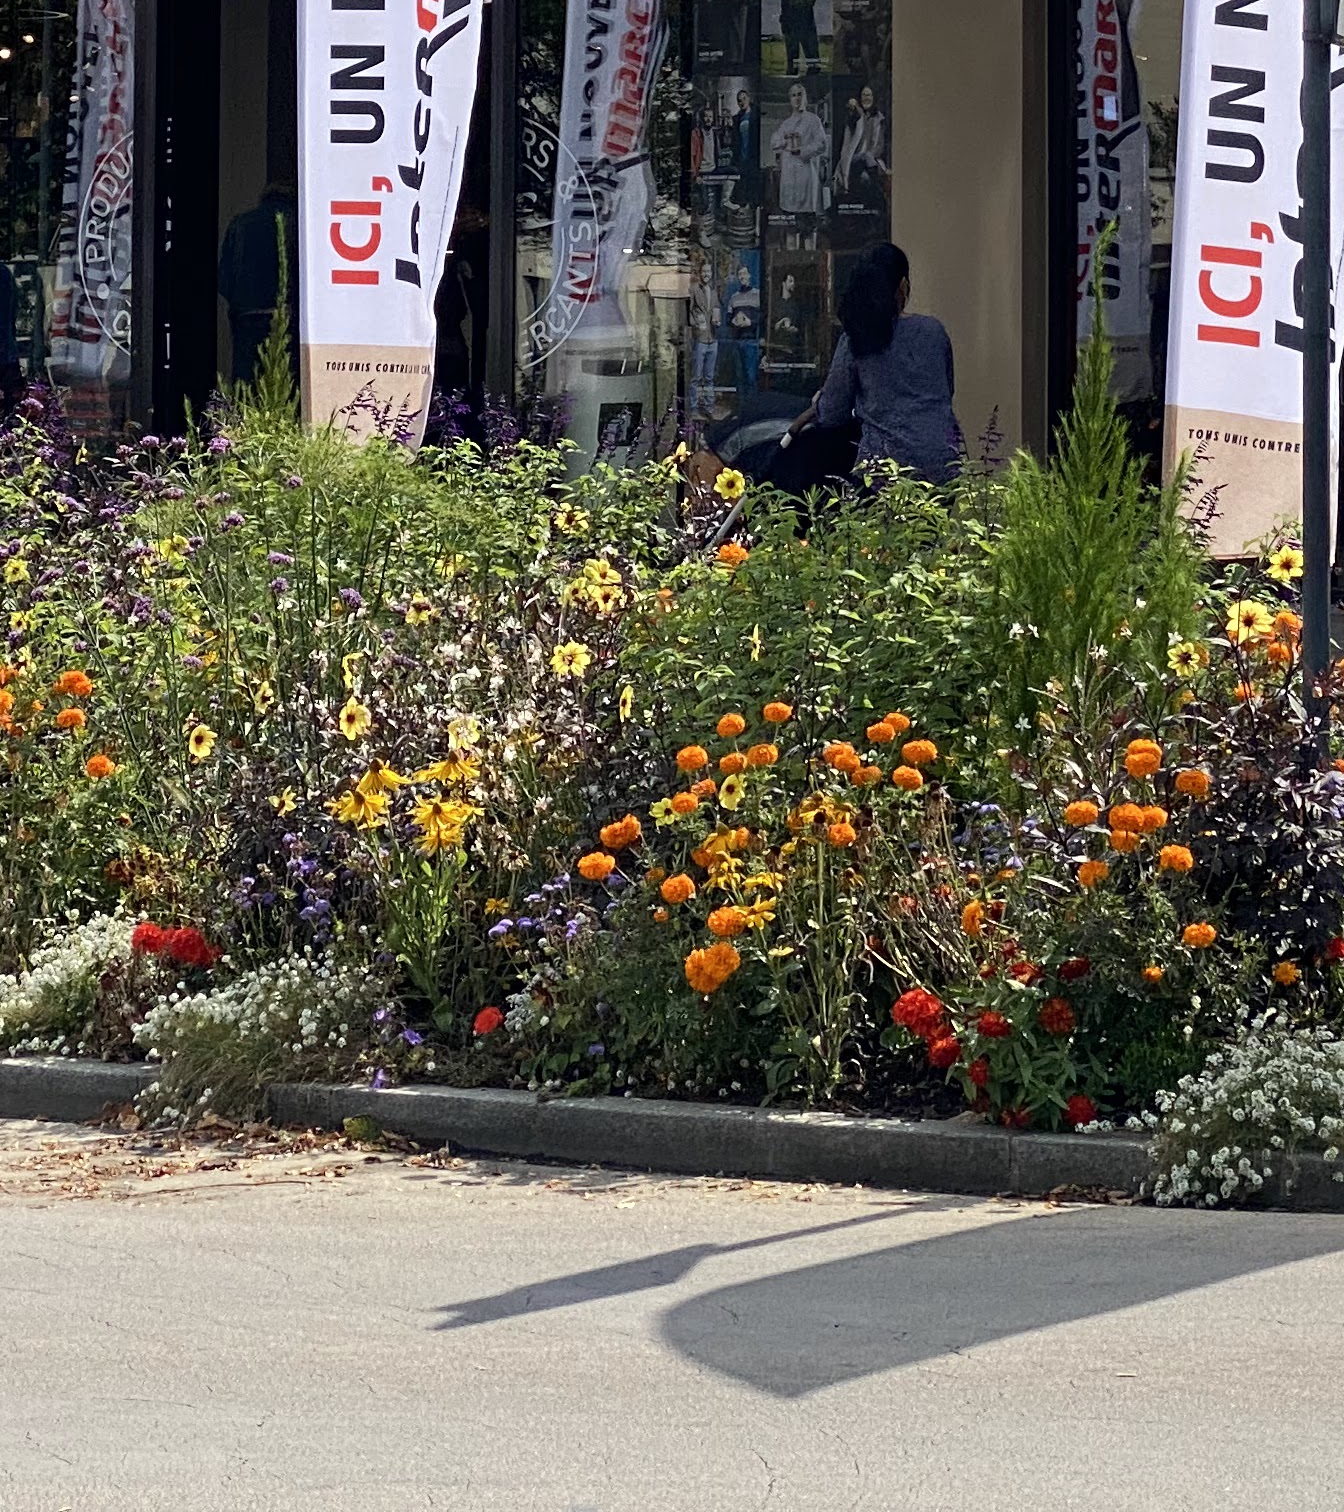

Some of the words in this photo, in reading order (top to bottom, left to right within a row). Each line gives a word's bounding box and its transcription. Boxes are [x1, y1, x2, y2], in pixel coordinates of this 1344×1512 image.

[330, 44, 385, 144] UN
[1204, 64, 1267, 184] UN
[329, 175, 394, 285] ICI,
[1197, 221, 1274, 348] ICI,
[325, 361, 346, 372] TOUS
[349, 362, 371, 373] UNIS
[1224, 432, 1249, 447] UNIS
[1252, 438, 1301, 454] CONTRE
